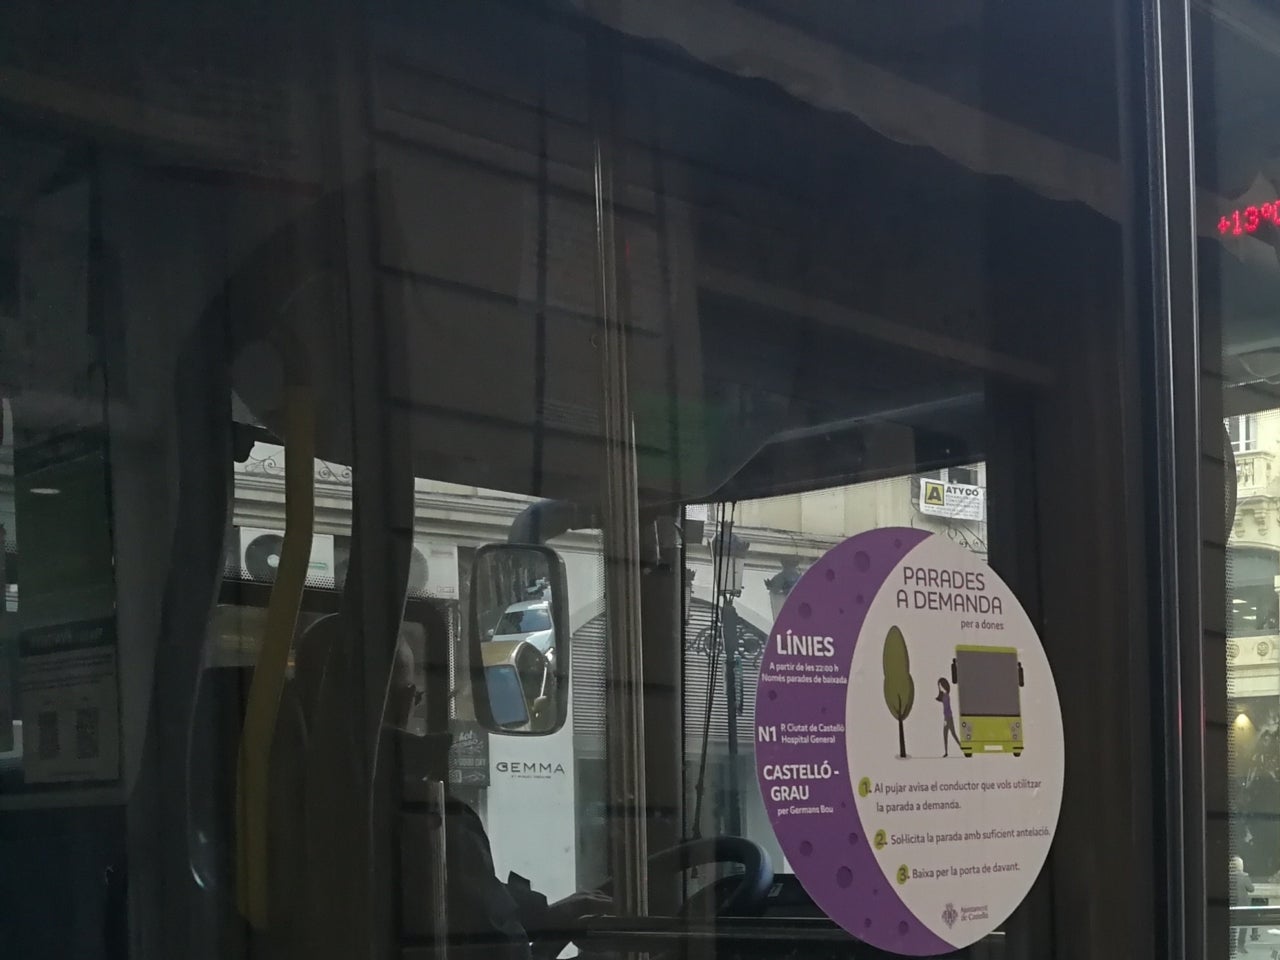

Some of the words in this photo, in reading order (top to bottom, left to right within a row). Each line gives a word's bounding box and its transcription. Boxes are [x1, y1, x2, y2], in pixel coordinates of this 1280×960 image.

[903, 566, 985, 591] PARADES
[896, 589, 909, 609] A
[914, 590, 1002, 615] DEMANDA
[960, 620, 973, 630] per
[981, 619, 1005, 630] dones
[776, 629, 835, 657] LÍNIES
[776, 662, 795, 672] partir
[796, 663, 804, 672] de
[786, 674, 813, 684] parades
[814, 675, 821, 683] de
[758, 725, 777, 742] N1
[787, 723, 808, 732] Ciutat
[809, 724, 818, 732] de
[781, 735, 810, 744] Hospital
[810, 735, 836, 744] General
[496, 761, 565, 775] GEMMA
[763, 760, 832, 780] CASTELLÓ
[771, 785, 809, 801] GRAU
[885, 782, 907, 795] pujar
[908, 781, 929, 792] avisa
[930, 781, 938, 791] el
[939, 780, 979, 792] conductor
[981, 782, 995, 792] que
[997, 778, 1012, 789] vols
[1013, 778, 1042, 789] utilitzar
[777, 807, 789, 817] per
[789, 806, 820, 815] Germans
[820, 805, 834, 813] Bou
[876, 802, 884, 812] la
[886, 801, 914, 814] parada
[922, 800, 961, 810] demanda.
[926, 832, 934, 843] la
[935, 832, 963, 845] parada
[964, 829, 982, 841] amb
[982, 829, 1015, 840] suficient
[912, 868, 934, 879] Baixa
[936, 869, 949, 879] per
[950, 866, 958, 876] la
[959, 865, 980, 877] porta
[981, 864, 991, 874] de
[992, 862, 1020, 873] davant.
